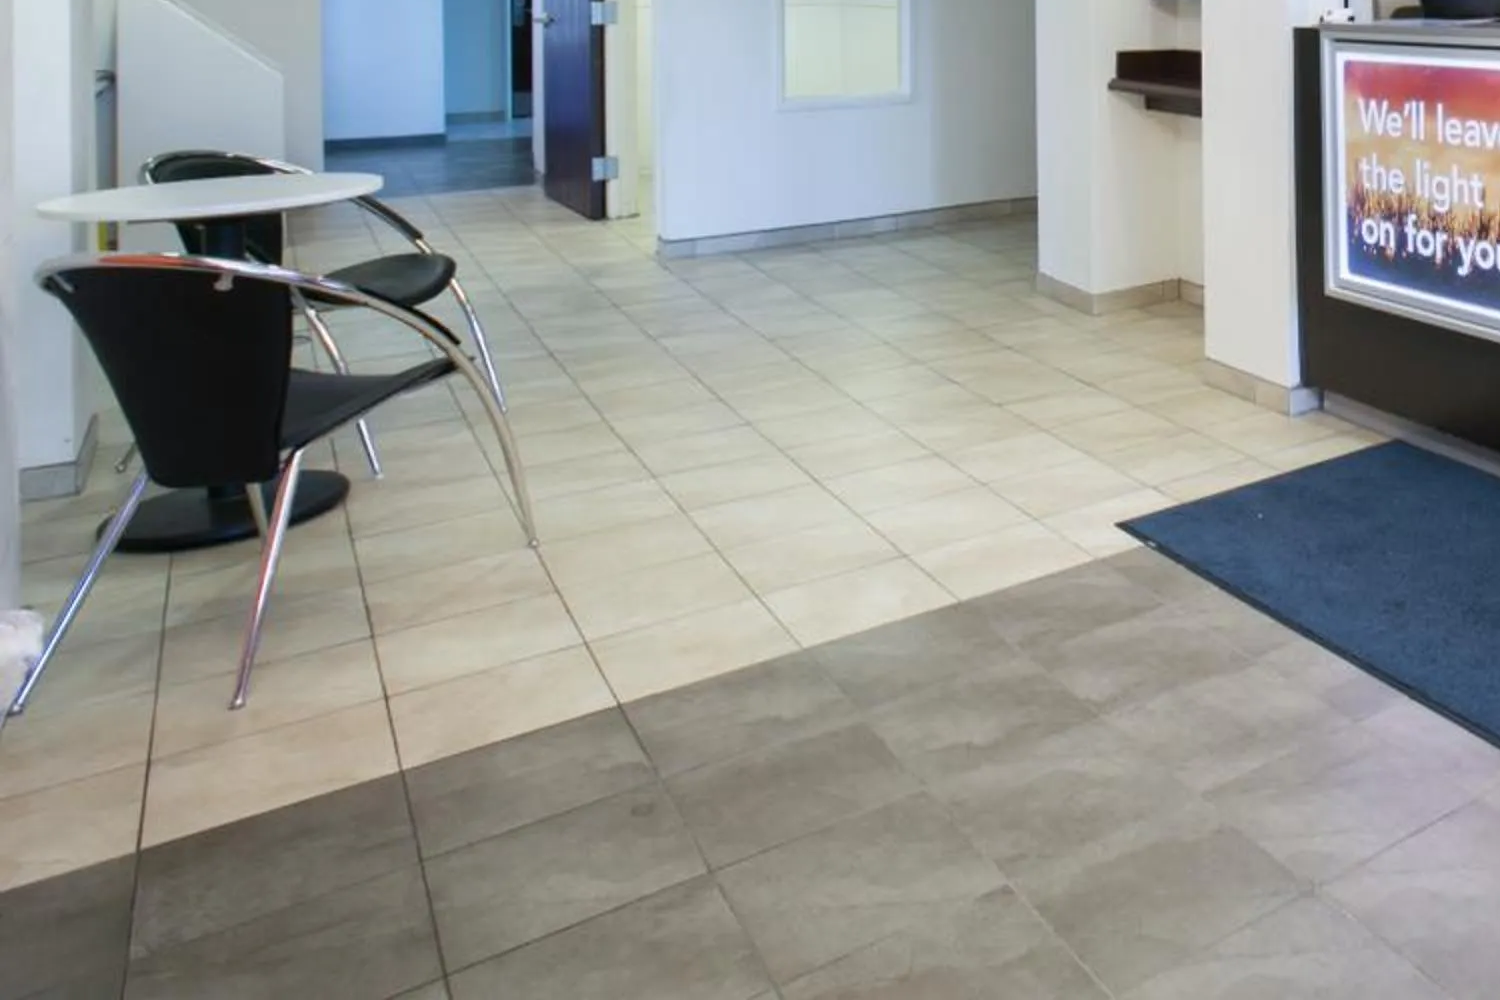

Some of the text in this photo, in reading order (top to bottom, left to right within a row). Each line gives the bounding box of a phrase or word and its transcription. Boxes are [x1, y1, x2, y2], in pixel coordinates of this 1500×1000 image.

[1358, 98, 1425, 140] We'll
[1358, 153, 1484, 213] the light
[1361, 217, 1396, 251] on
[1404, 213, 1449, 263] for
